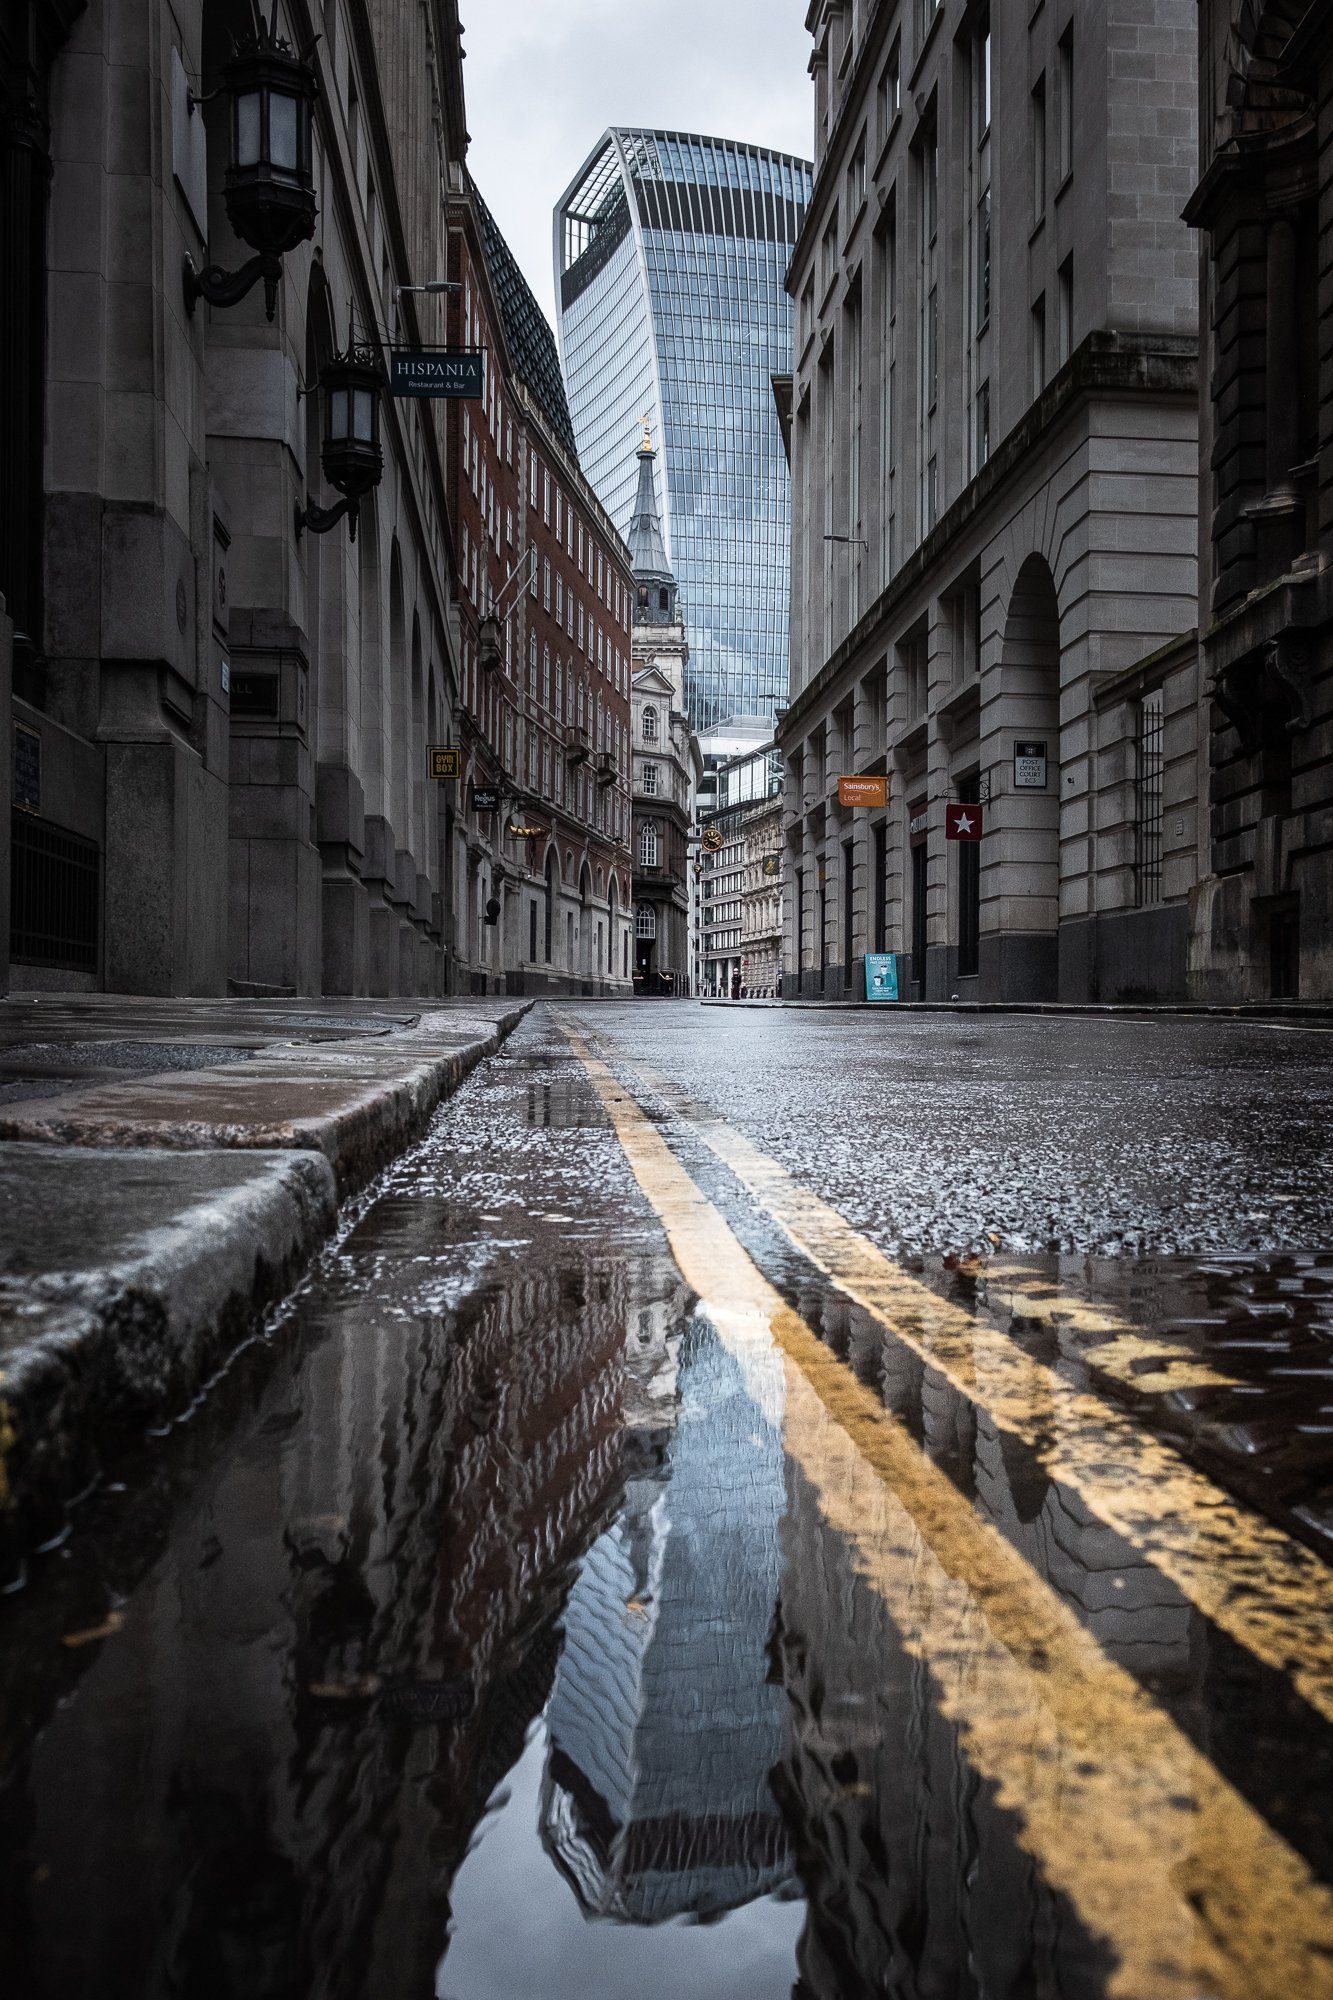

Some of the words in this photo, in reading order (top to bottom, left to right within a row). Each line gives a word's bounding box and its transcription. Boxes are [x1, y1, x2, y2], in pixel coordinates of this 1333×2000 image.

[396, 362, 477, 376] HISPANIA
[436, 755, 454, 763] GYM
[436, 764, 453, 772] BOX
[843, 783, 880, 791] Sainsbury's
[474, 793, 496, 804] Regus
